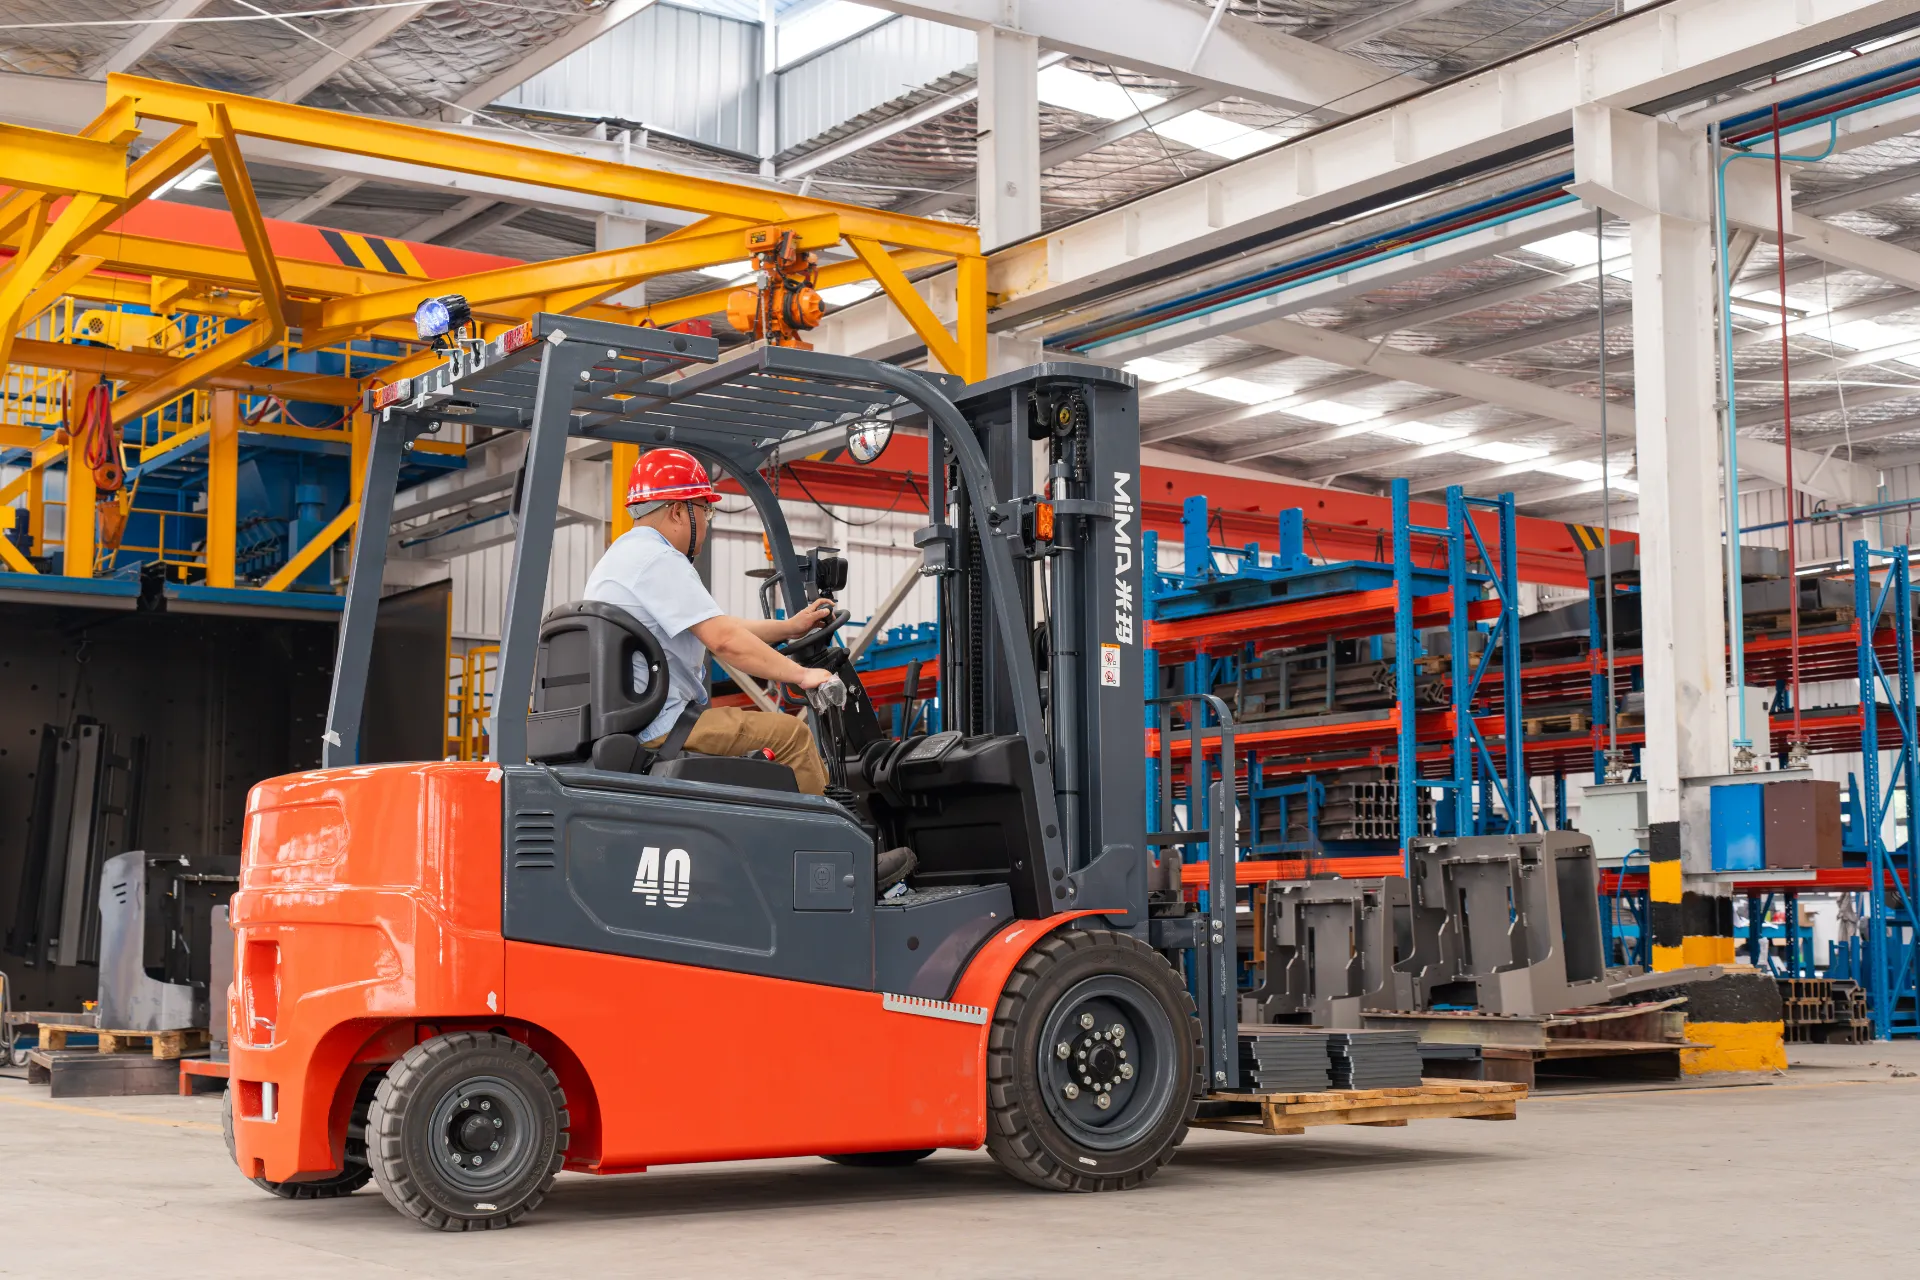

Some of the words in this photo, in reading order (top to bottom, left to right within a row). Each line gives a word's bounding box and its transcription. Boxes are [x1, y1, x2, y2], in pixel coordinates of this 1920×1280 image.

[1113, 471, 1135, 576] MiMA
[1115, 577, 1133, 646] 米玛
[632, 846, 691, 908] 40
